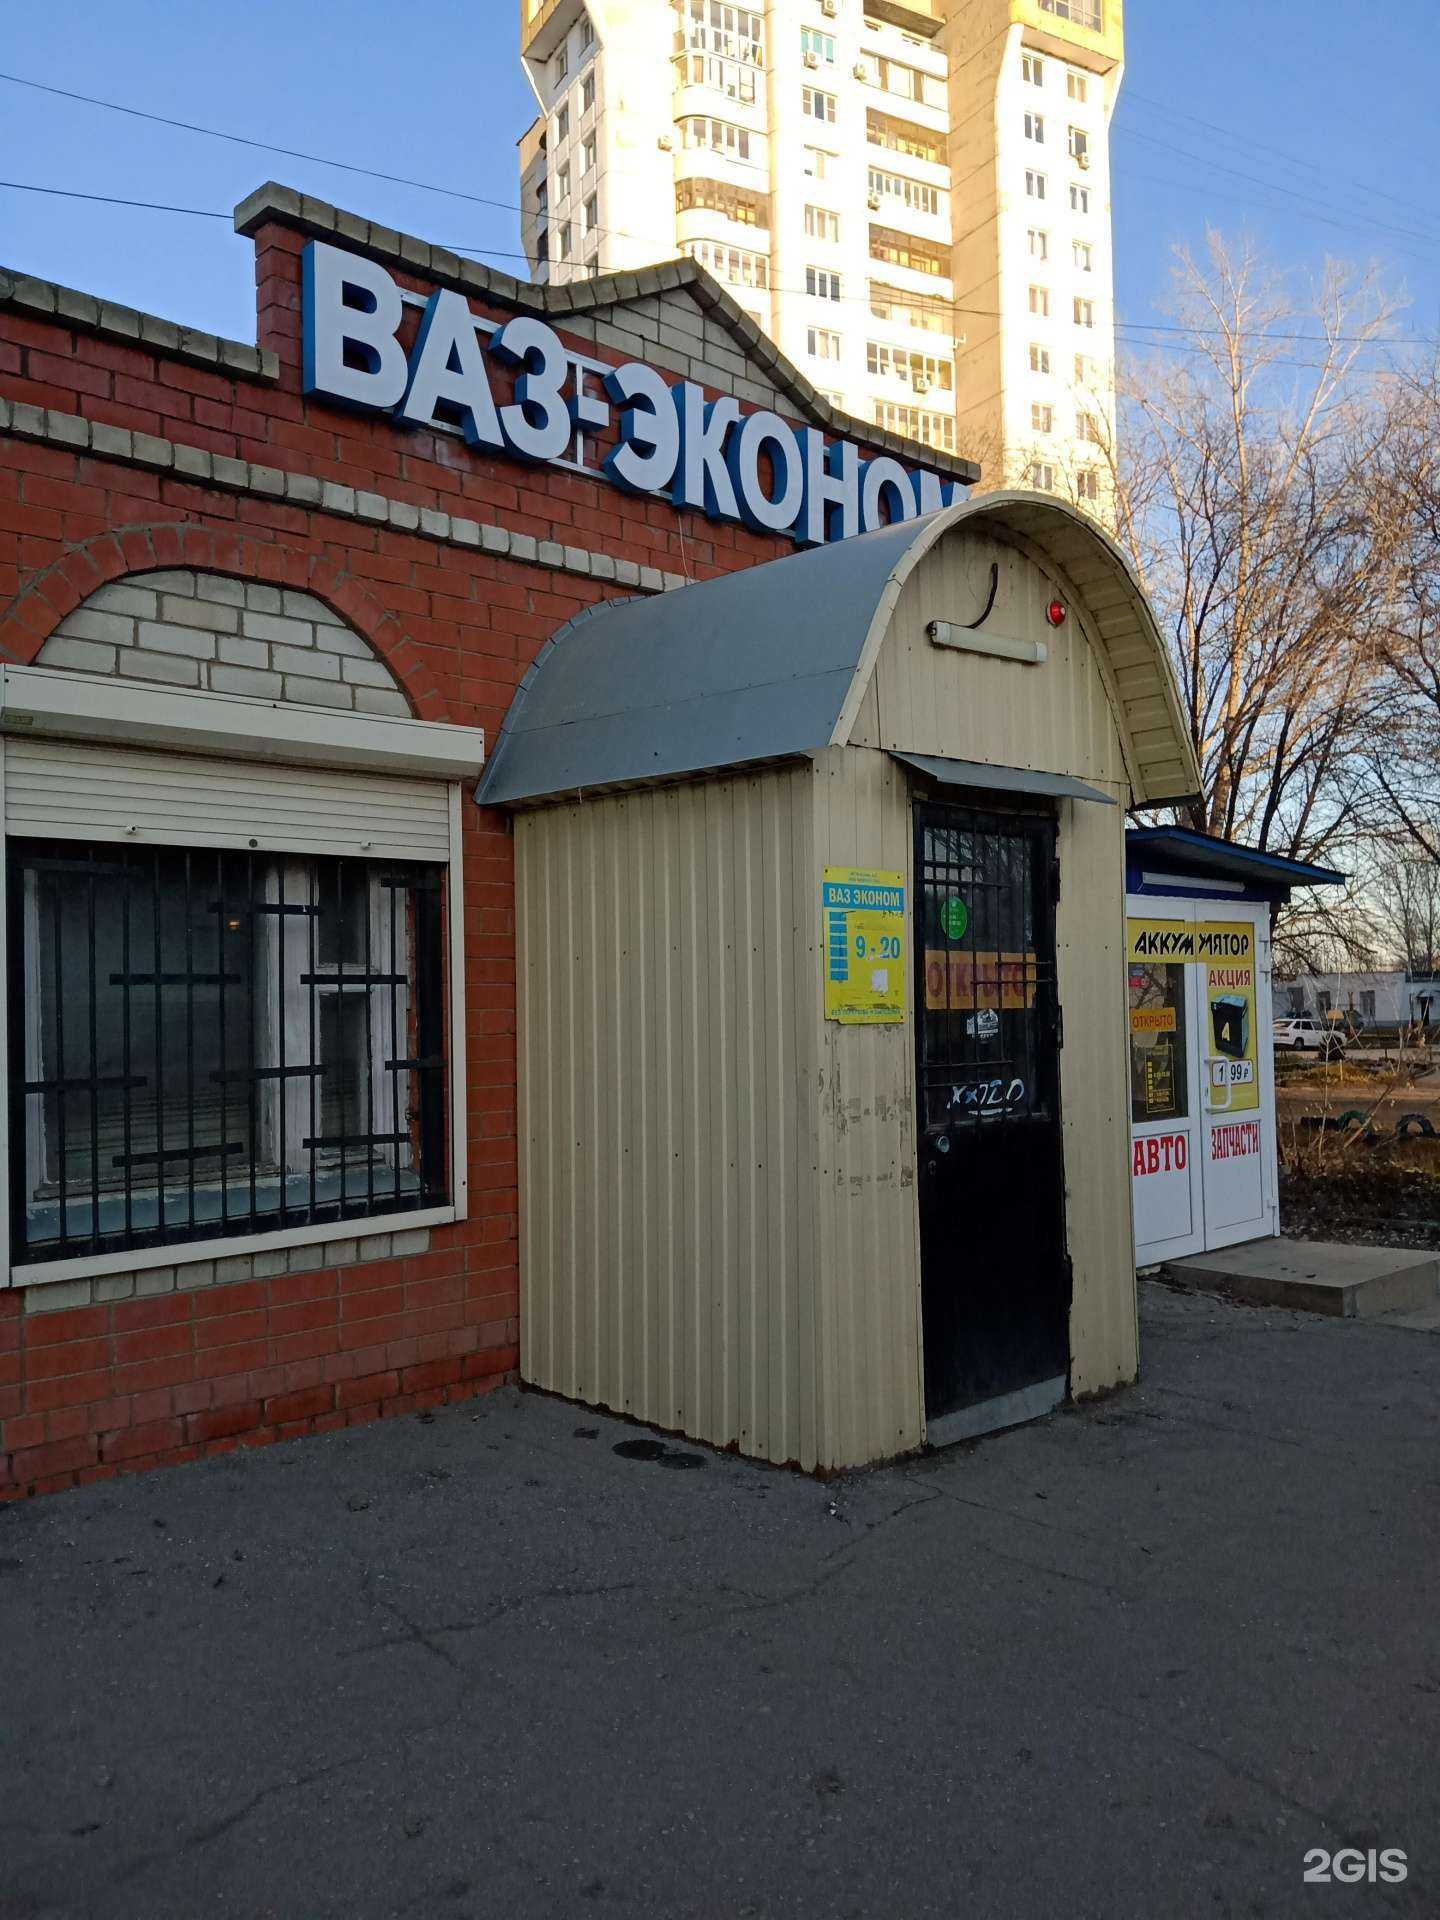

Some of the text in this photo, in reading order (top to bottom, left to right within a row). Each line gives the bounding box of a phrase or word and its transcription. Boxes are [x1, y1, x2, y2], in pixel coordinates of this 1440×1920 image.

[829, 888, 900, 907] ВАЗ ЭКОНОМ
[856, 936, 866, 958] 9
[880, 936, 900, 959] 20
[1209, 969, 1251, 988] АКЦИЯ
[1133, 1014, 1172, 1028] ОТКРЫТО
[1133, 1123, 1259, 1176] АВТО ЗАПЧАСТИ
